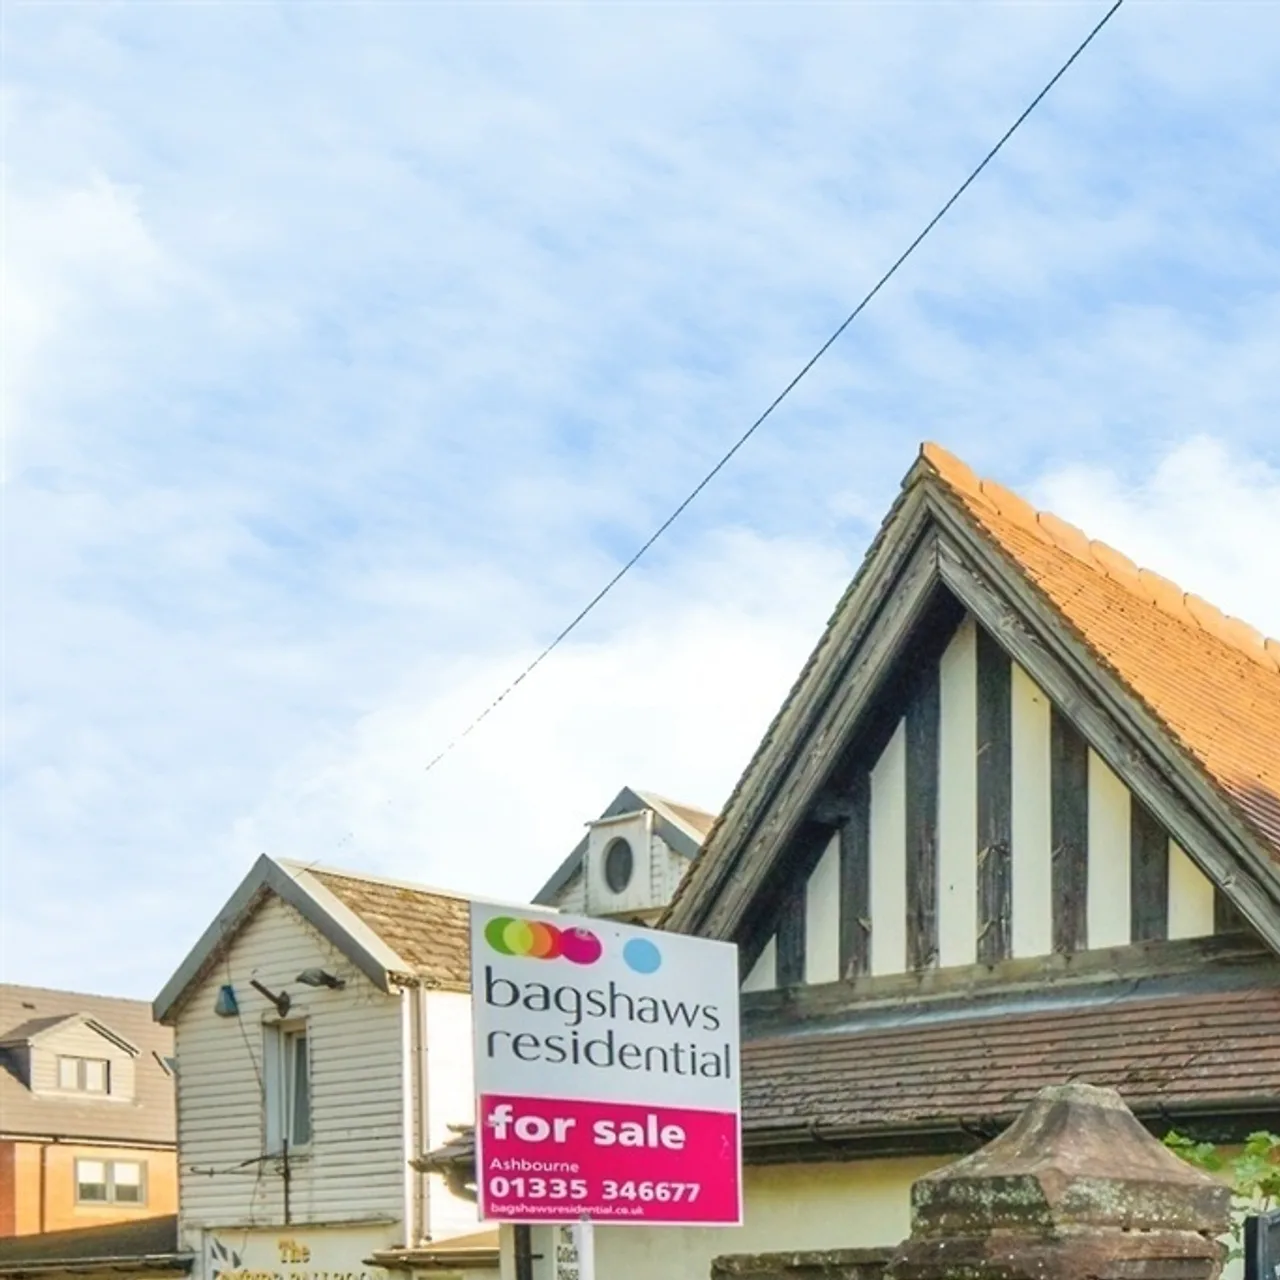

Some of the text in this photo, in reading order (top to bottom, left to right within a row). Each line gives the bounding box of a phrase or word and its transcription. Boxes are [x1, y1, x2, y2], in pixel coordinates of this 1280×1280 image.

[484, 965, 721, 1032] bagshaws
[487, 1029, 731, 1079] residential
[487, 1104, 686, 1150] for sale
[489, 1157, 580, 1174] Ashbourne
[489, 1176, 701, 1203] 01335 346677
[490, 1202, 645, 1216] bagshawsresidential.co.uk
[277, 1237, 311, 1264] The
